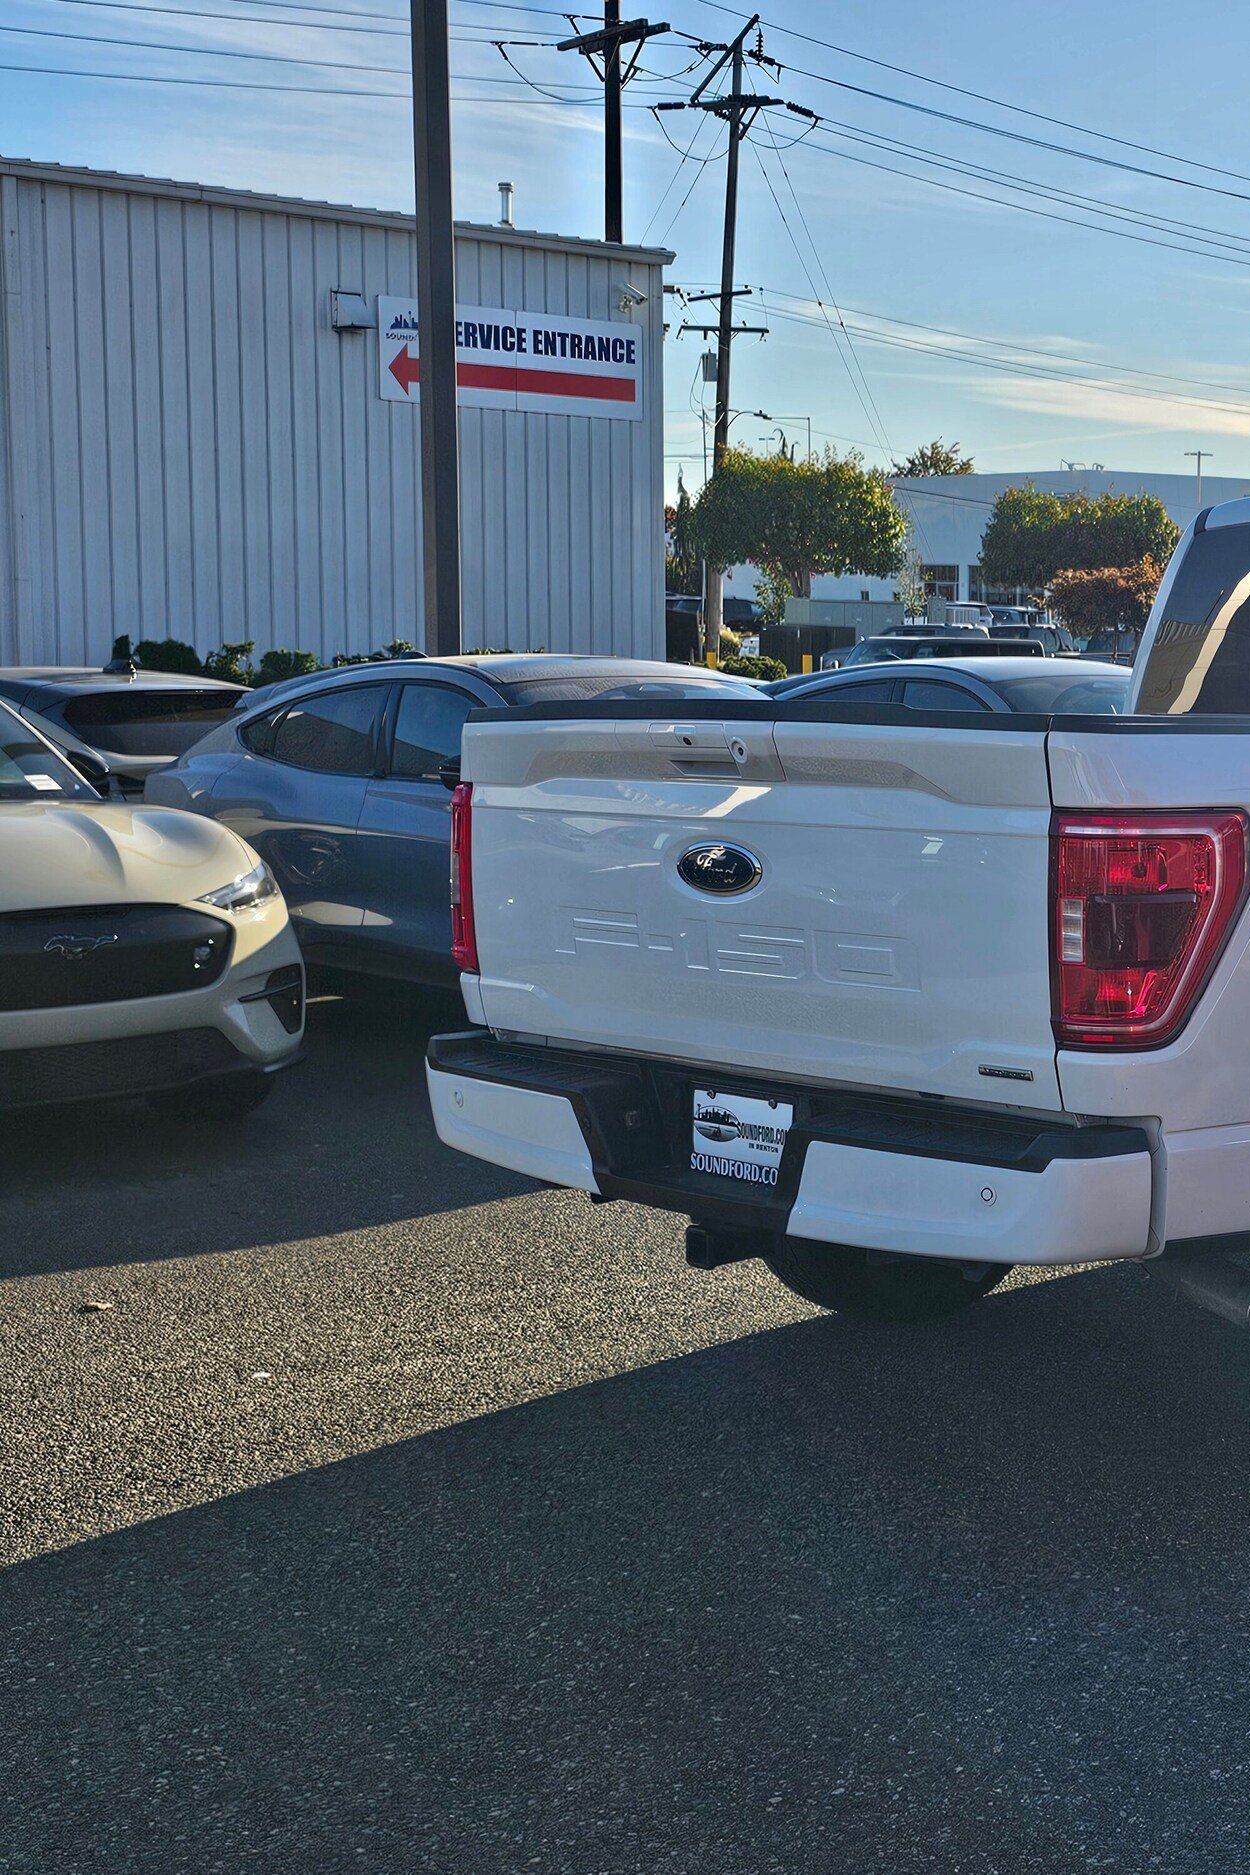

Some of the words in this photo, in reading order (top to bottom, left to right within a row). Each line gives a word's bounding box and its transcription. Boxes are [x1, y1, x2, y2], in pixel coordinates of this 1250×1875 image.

[385, 332, 418, 342] SOUND
[456, 321, 527, 353] ERVICE
[533, 329, 635, 364] ENTRANCE
[555, 906, 920, 993] F-150
[756, 1144, 779, 1153] RENTON
